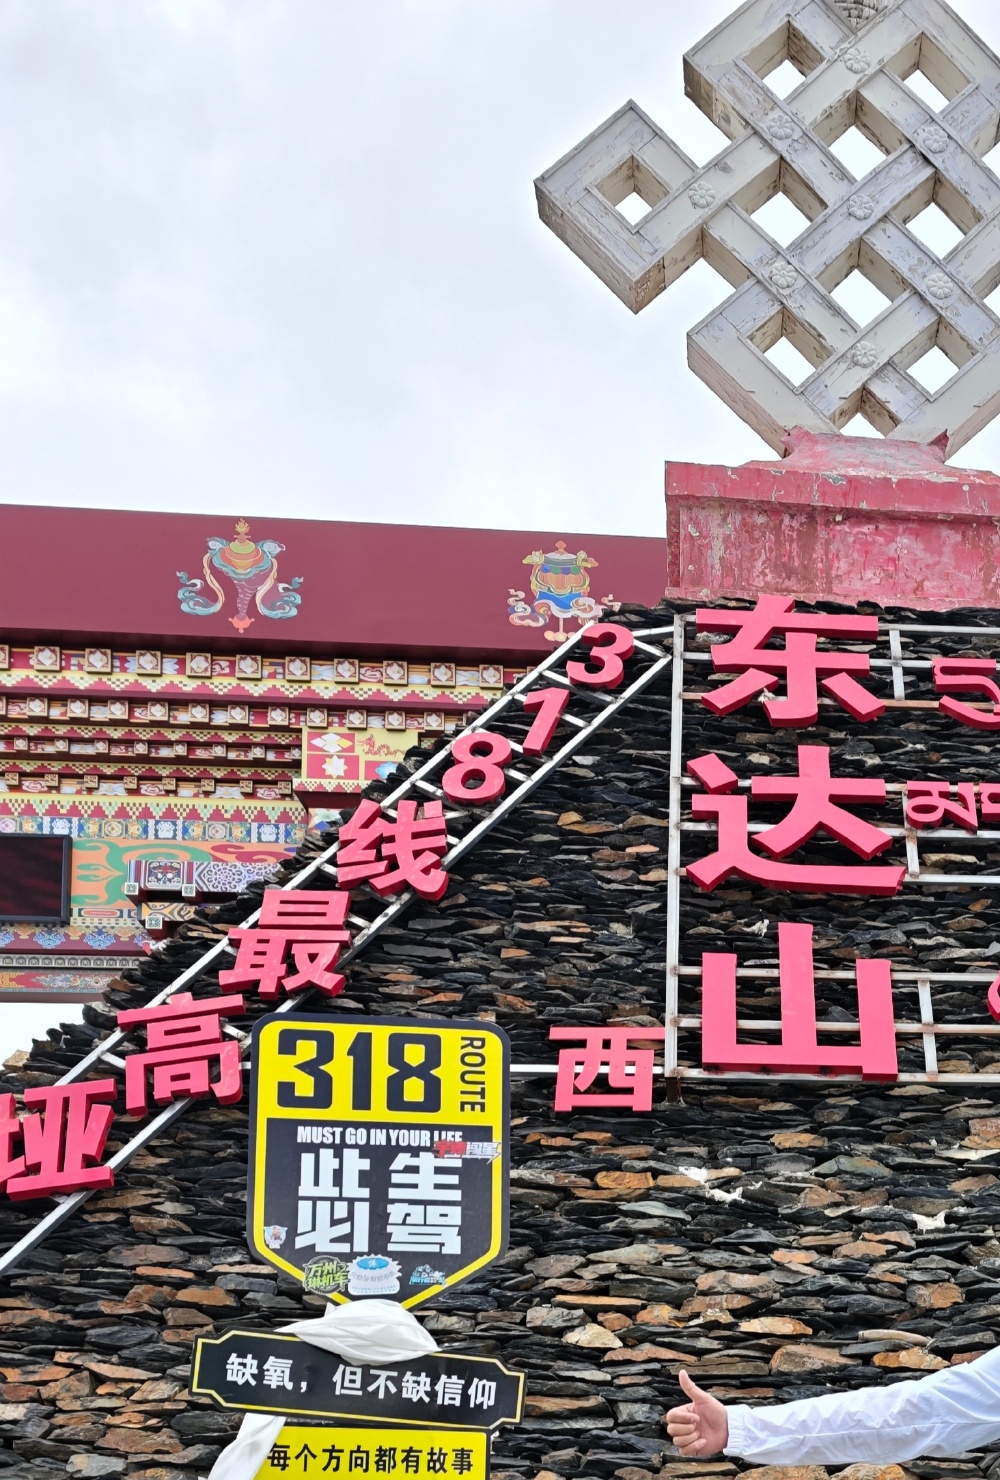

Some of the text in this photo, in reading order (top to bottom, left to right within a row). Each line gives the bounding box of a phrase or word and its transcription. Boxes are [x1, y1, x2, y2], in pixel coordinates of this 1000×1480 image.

[686, 594, 906, 1081] 东达山
[277, 1028, 443, 1114] 318
[459, 1035, 486, 1114] ROUTE
[297, 1126, 343, 1144] MUST
[345, 1127, 368, 1146] GO
[370, 1128, 387, 1146] IN
[389, 1129, 431, 1147] YOUR
[297, 1148, 463, 1201] 此生
[295, 1201, 462, 1255] 必驾
[267, 1442, 474, 1476] 每个方向都有故事
